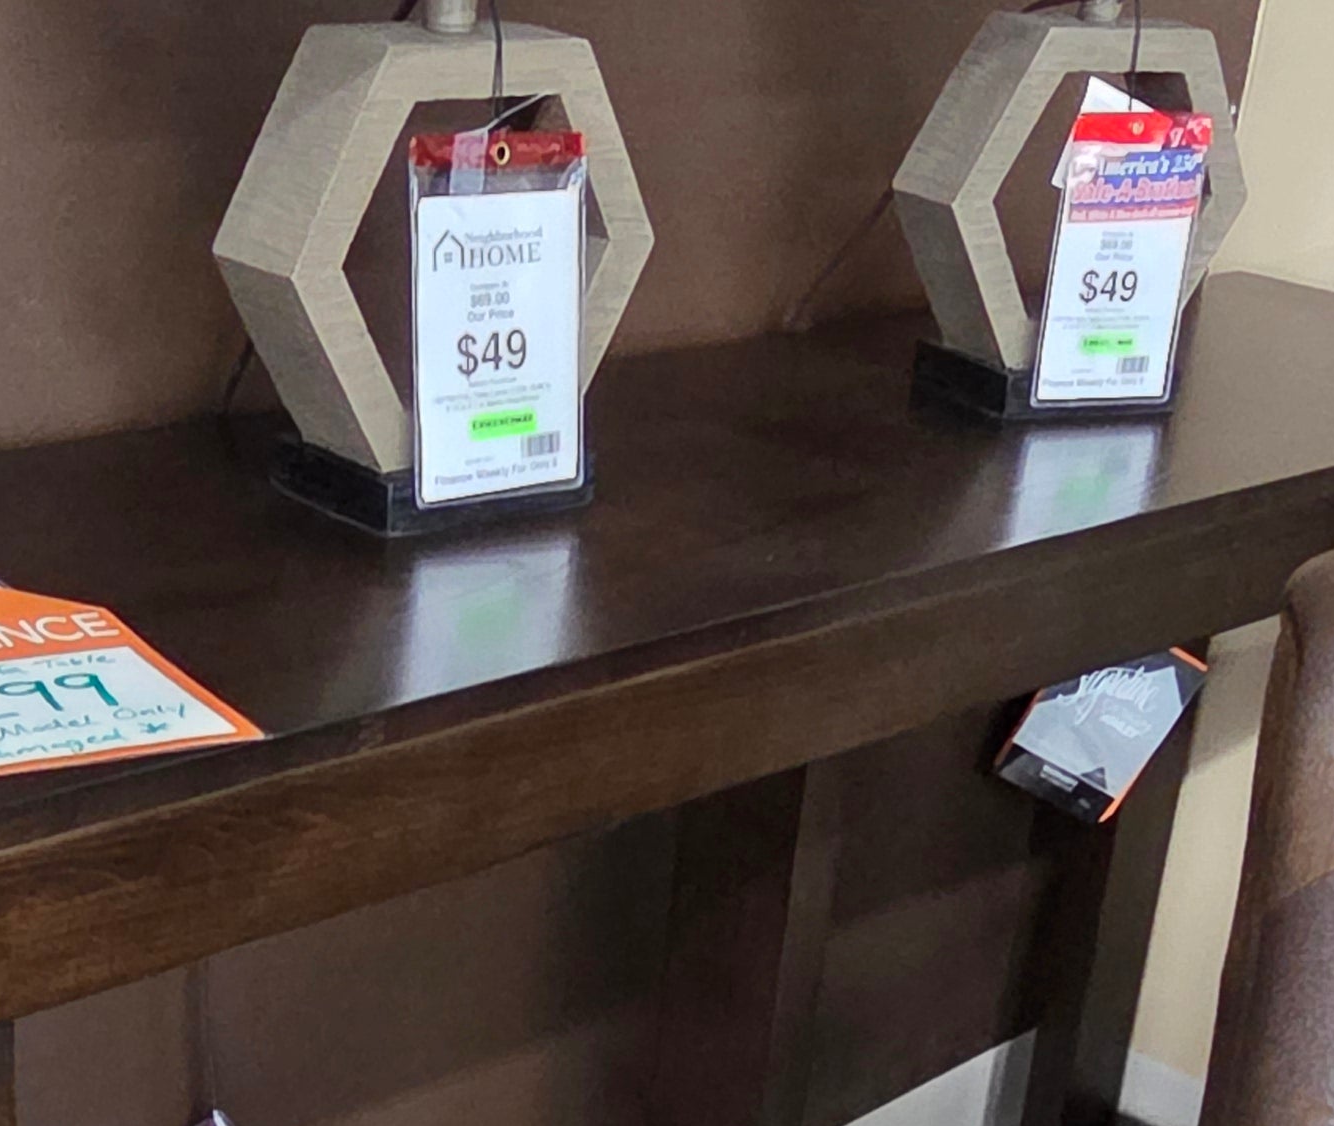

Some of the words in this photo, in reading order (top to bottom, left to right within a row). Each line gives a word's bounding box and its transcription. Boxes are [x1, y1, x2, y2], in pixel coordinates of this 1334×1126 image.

[469, 241, 542, 269] HOME
[1078, 269, 1139, 304] $49
[457, 328, 528, 381] $49
[31, 653, 117, 669] Table
[113, 702, 187, 722] Only
